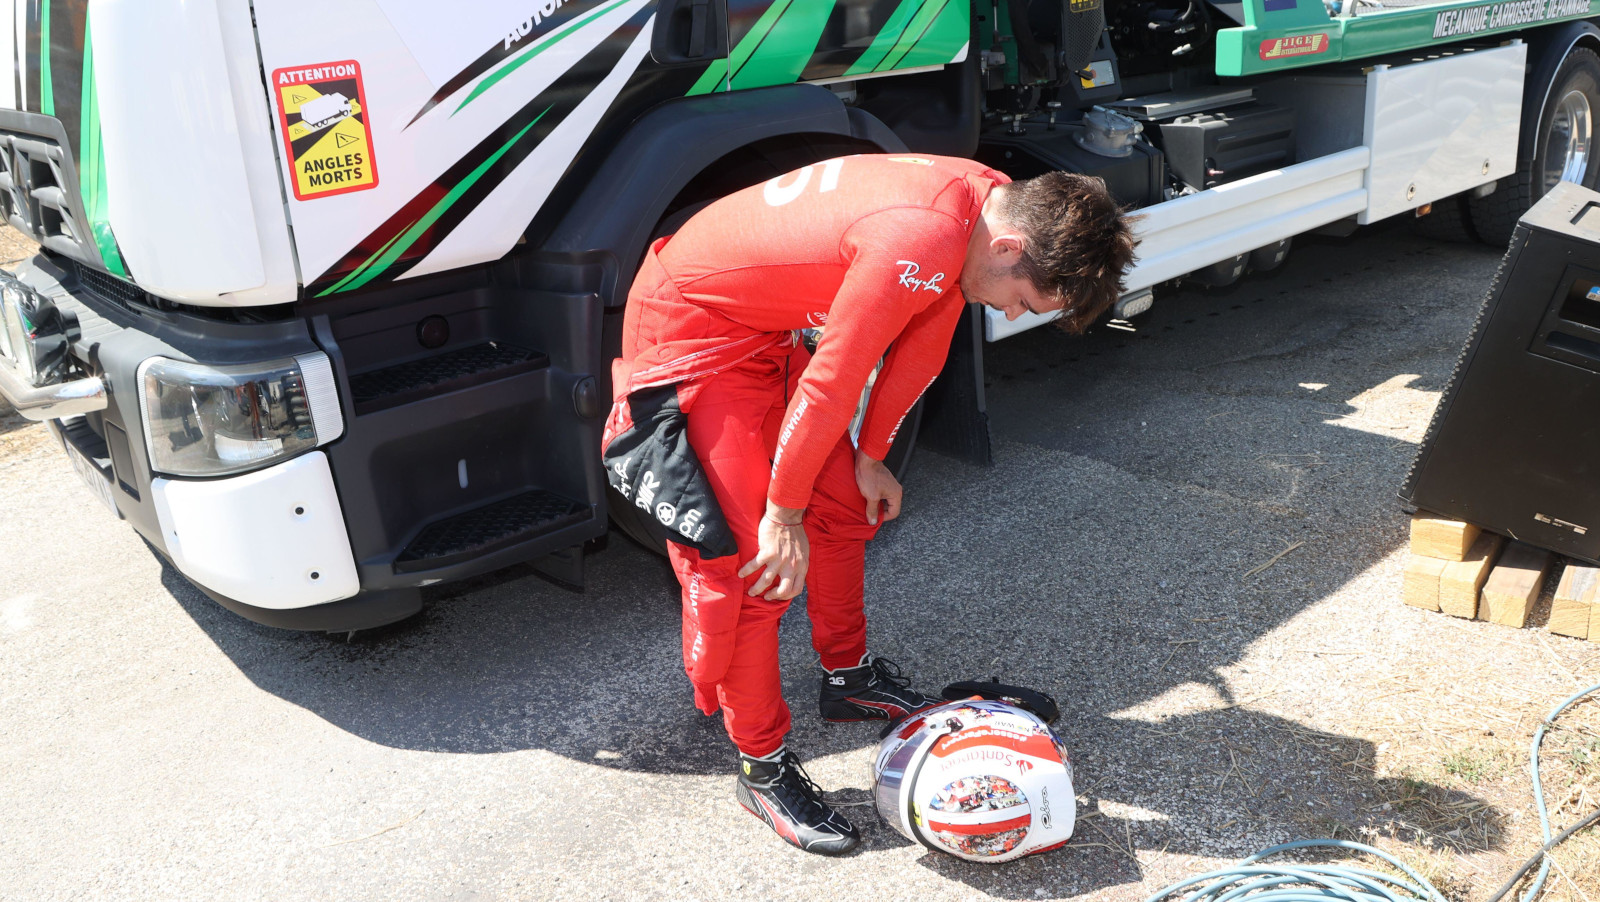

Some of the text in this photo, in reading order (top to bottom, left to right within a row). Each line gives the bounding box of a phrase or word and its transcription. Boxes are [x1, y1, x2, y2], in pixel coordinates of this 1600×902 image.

[1433, 6, 1490, 39] MECANIQUE
[1489, 0, 1548, 28] CARROSSERIE
[1283, 36, 1312, 47] JIGE
[279, 64, 356, 84] ATTENTION
[304, 153, 363, 173] ANGLES
[309, 167, 363, 187] MORTS
[896, 260, 945, 294] Ray-Ban
[771, 397, 808, 480] RICHARD MILLE
[829, 676, 845, 686] 16
